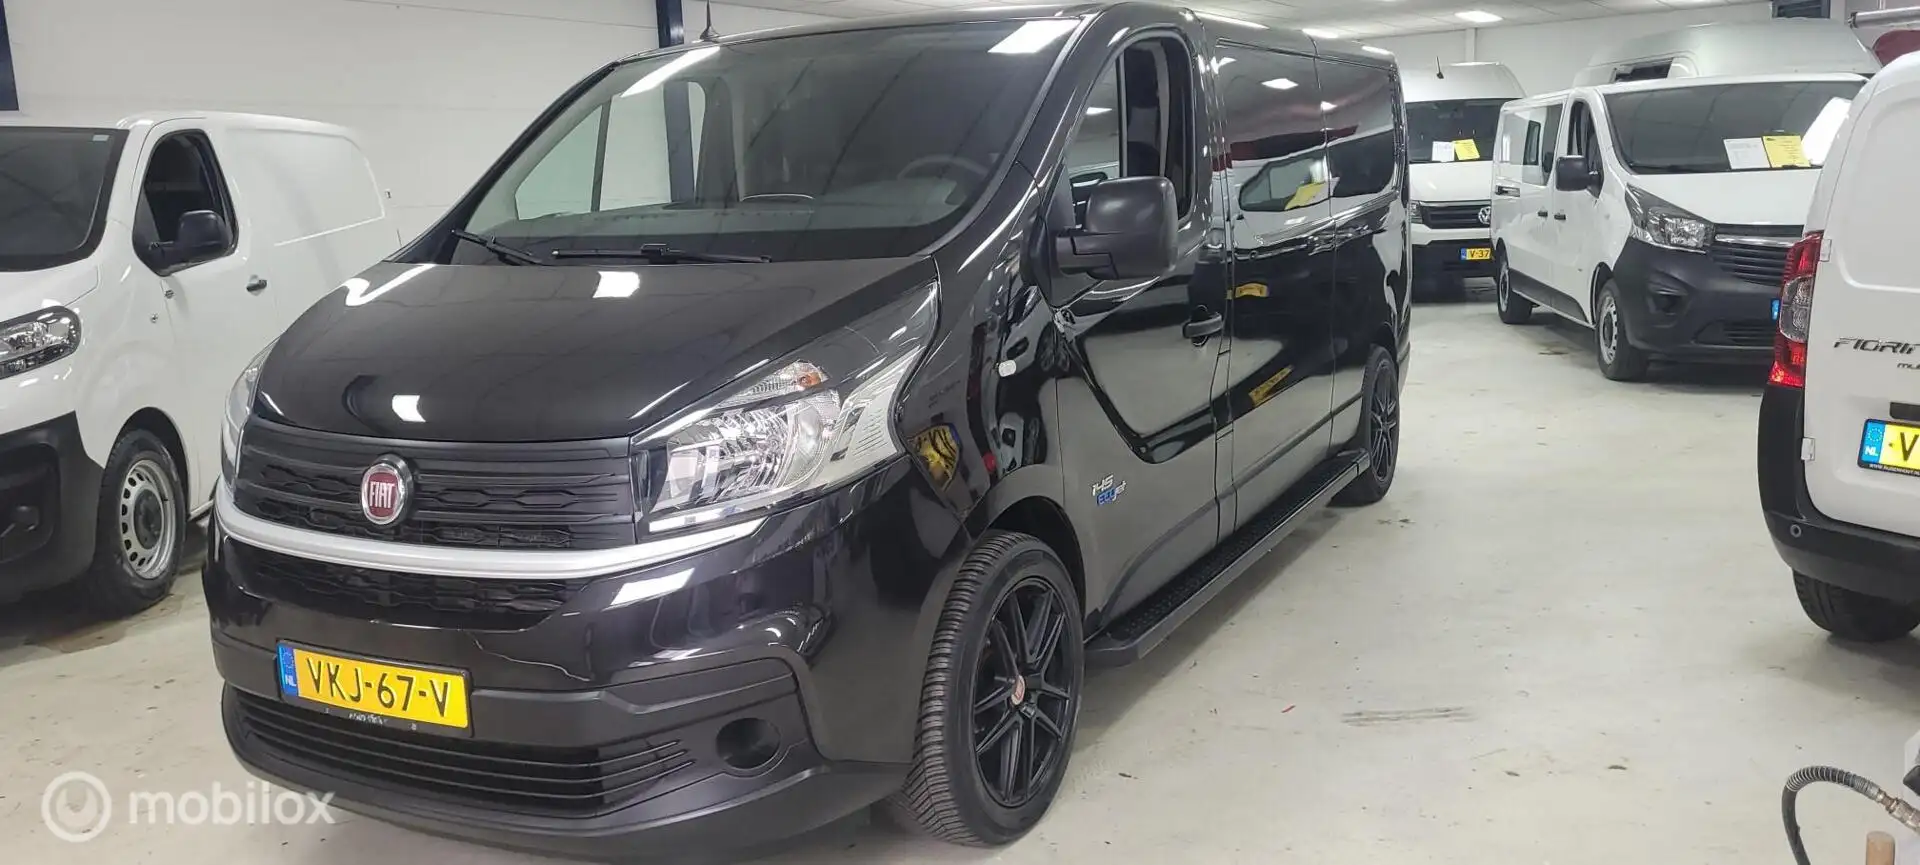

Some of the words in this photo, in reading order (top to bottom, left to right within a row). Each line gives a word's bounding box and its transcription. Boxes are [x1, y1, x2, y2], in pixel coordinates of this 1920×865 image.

[1864, 445, 1879, 457] NL
[369, 481, 396, 509] FIAT
[1092, 474, 1114, 496] 145
[285, 674, 297, 687] NL
[306, 657, 449, 718] VKJ-67-V
